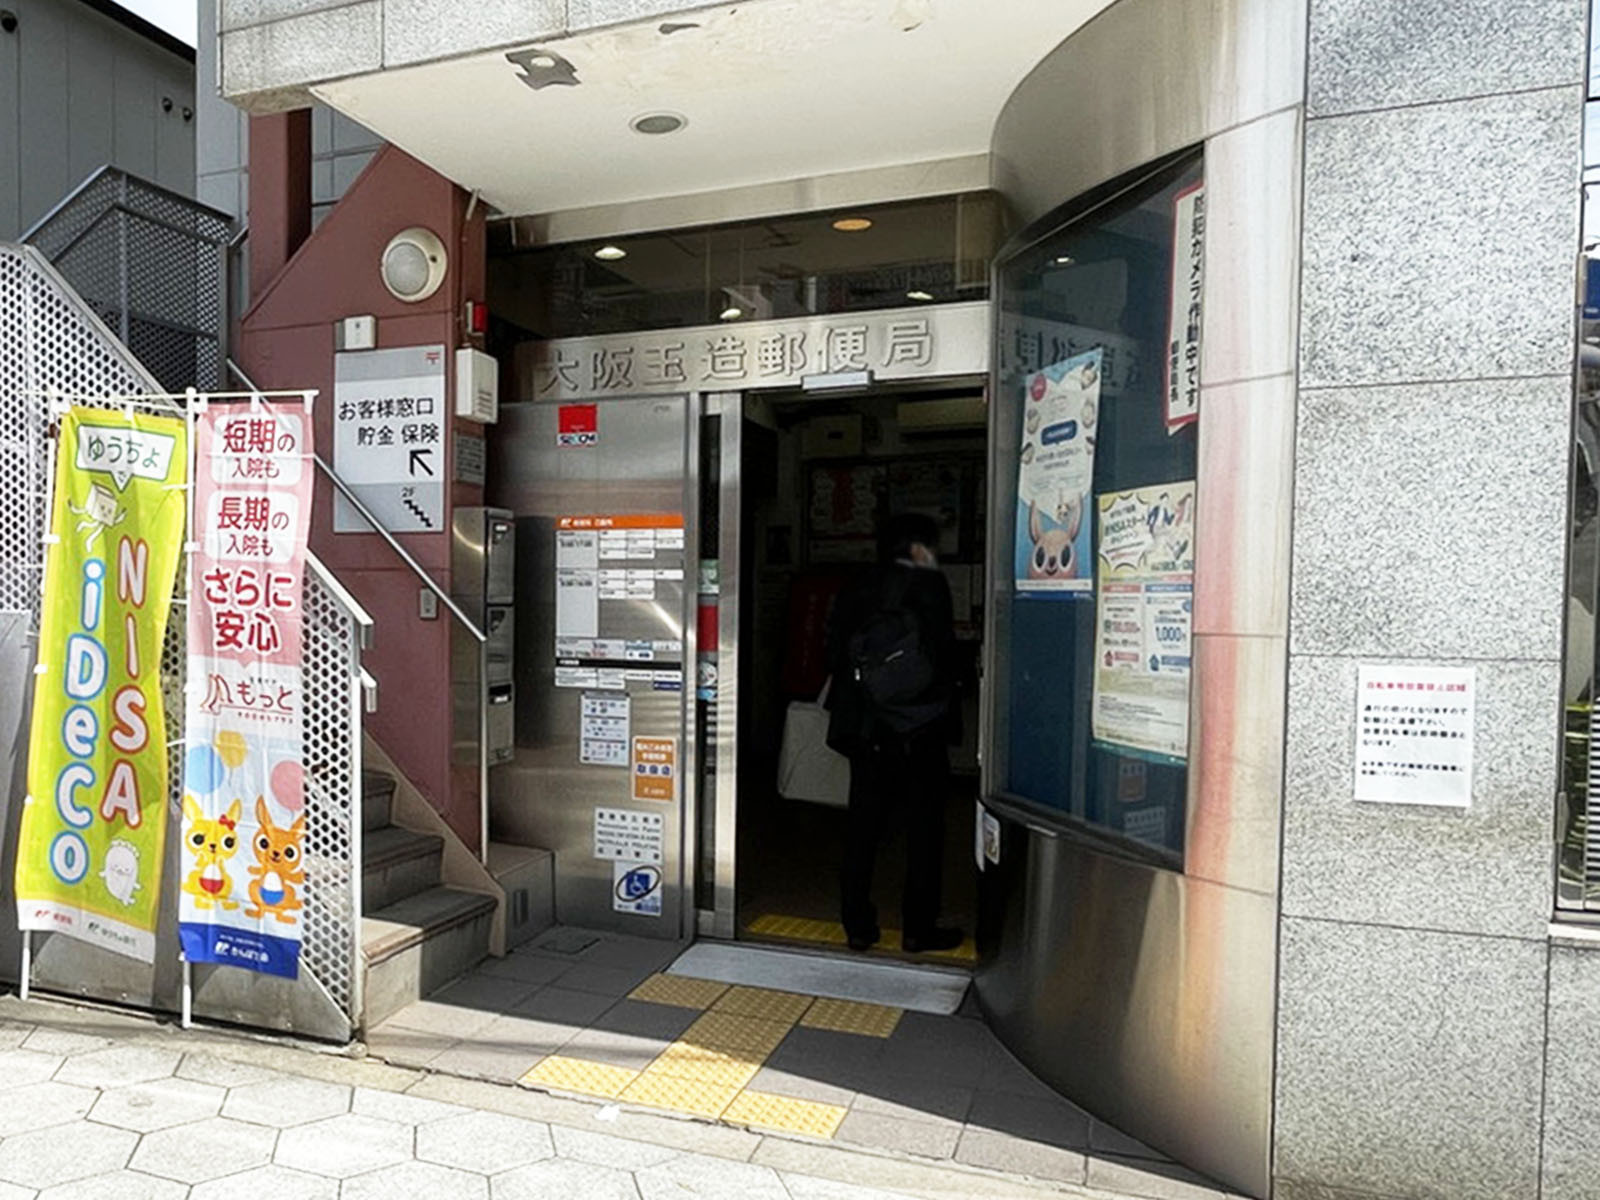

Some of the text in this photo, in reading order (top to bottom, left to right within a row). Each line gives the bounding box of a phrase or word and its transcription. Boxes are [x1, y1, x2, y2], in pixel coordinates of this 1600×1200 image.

[539, 319, 934, 393] 大阪玉造郵便局
[338, 397, 434, 421] お客様窓口
[87, 435, 160, 468] ゆうちょ
[223, 418, 296, 453] 短期の
[357, 423, 439, 446] 貯金 保険
[231, 457, 280, 478] 入院も
[217, 496, 290, 532] 長期の
[225, 533, 274, 556] 入院も
[204, 568, 293, 609] さらに
[215, 609, 279, 651] 安心
[100, 536, 149, 829] NISA
[237, 681, 293, 711] もっと
[50, 558, 108, 884] iDeCo
